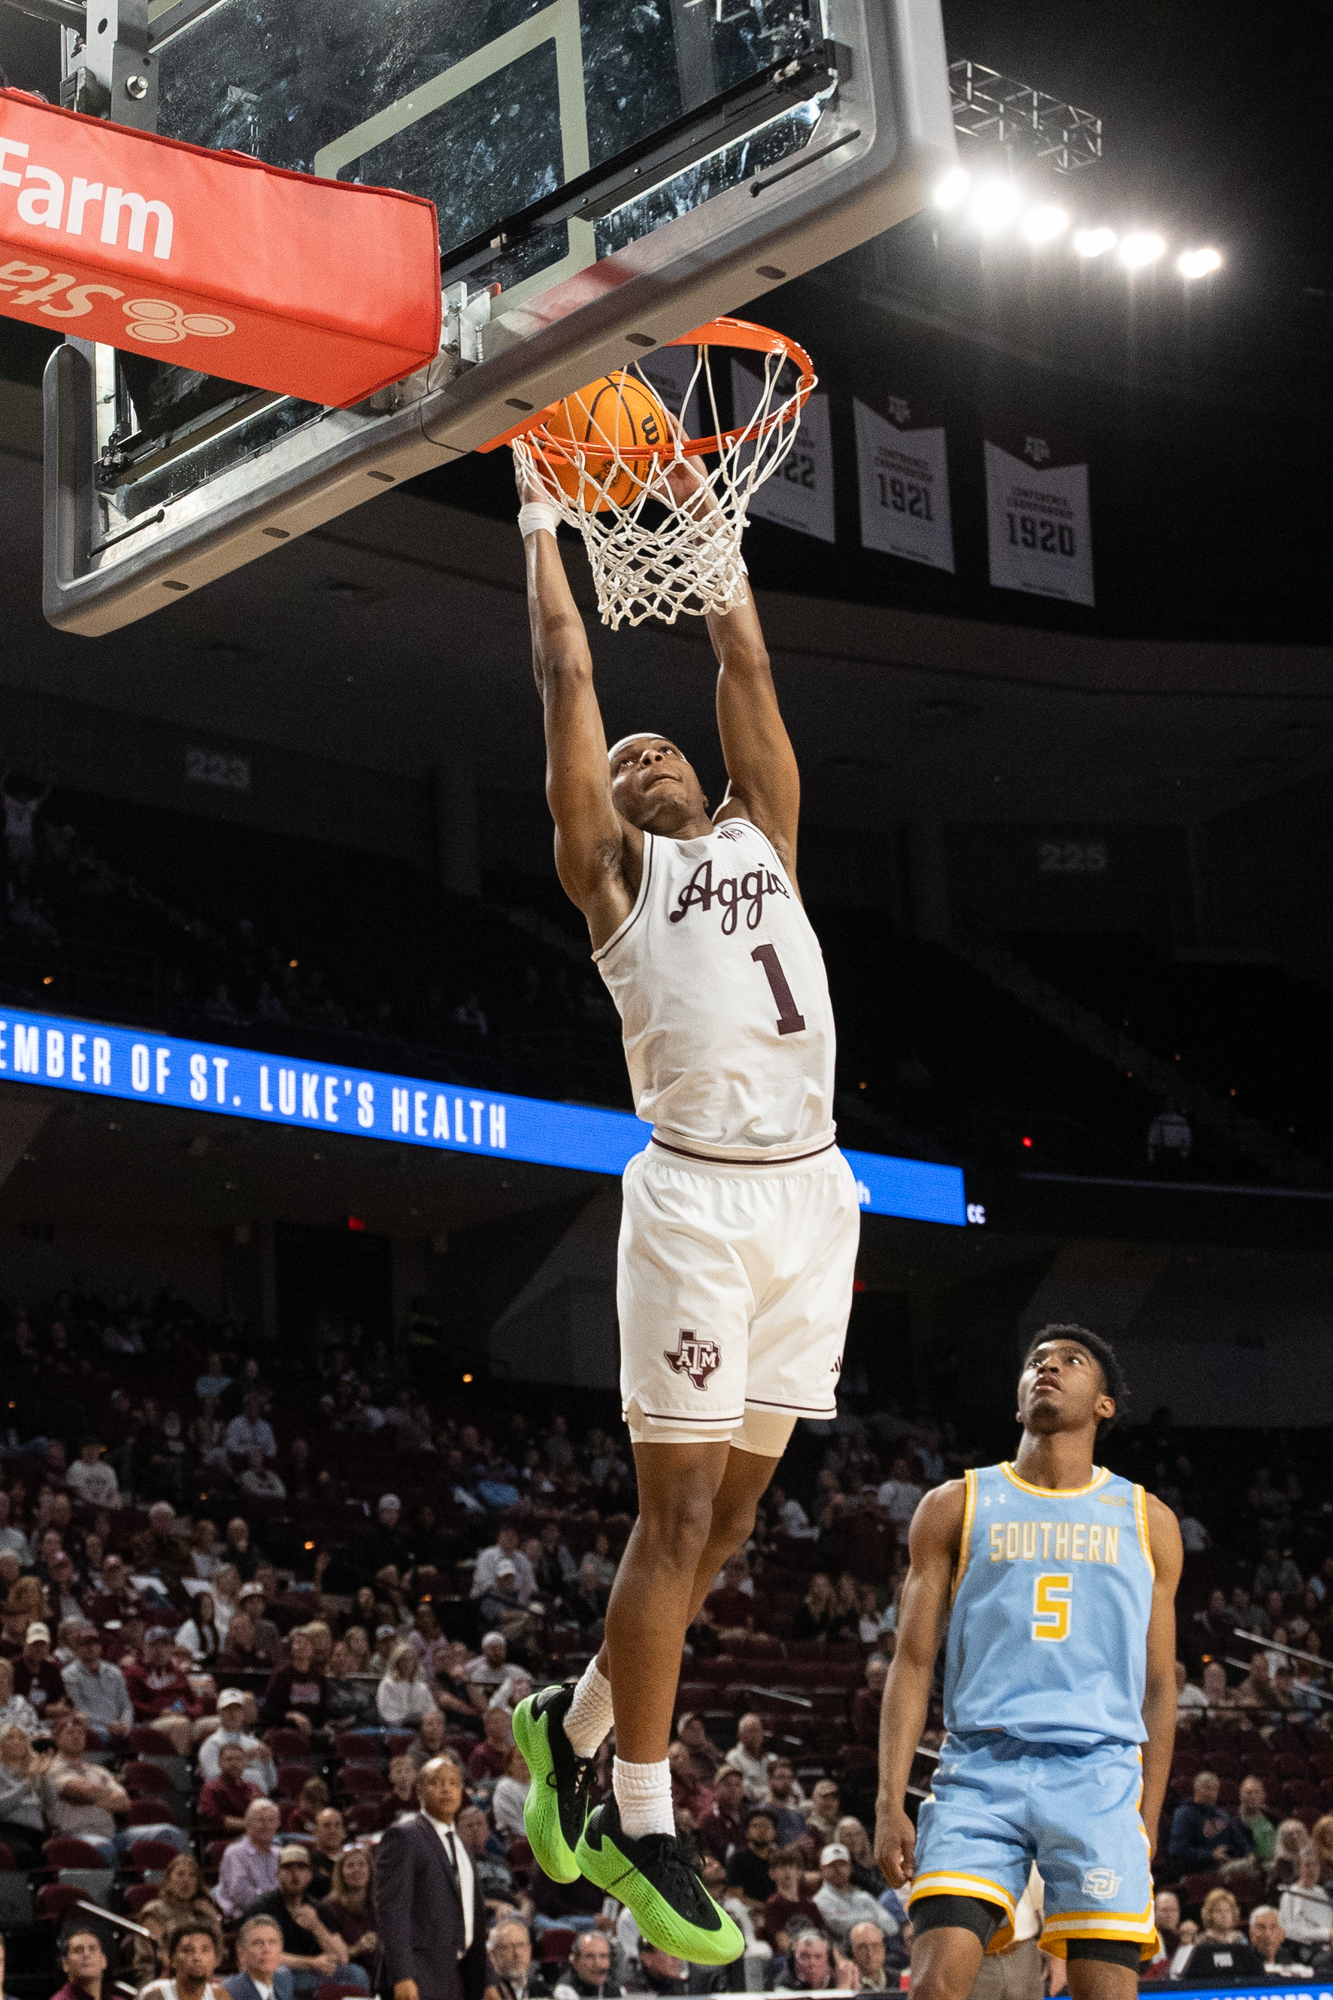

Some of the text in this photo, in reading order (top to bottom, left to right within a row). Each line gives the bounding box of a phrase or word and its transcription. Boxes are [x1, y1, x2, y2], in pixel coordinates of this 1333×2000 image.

[0, 137, 174, 260] Farm
[877, 473, 935, 522] 1921
[1006, 512, 1076, 558] 1920
[186, 748, 249, 790] 223
[1039, 842, 1106, 871] 225
[750, 943, 806, 1035] 1
[131, 1043, 171, 1094] OF
[190, 1053, 241, 1106] ST.
[260, 1065, 374, 1128] LUKE'S
[392, 1086, 506, 1149] HEALTH
[989, 1522, 1120, 1565] SOUTHERN
[1031, 1572, 1073, 1643] 5
[1081, 1868, 1123, 1899] SU
